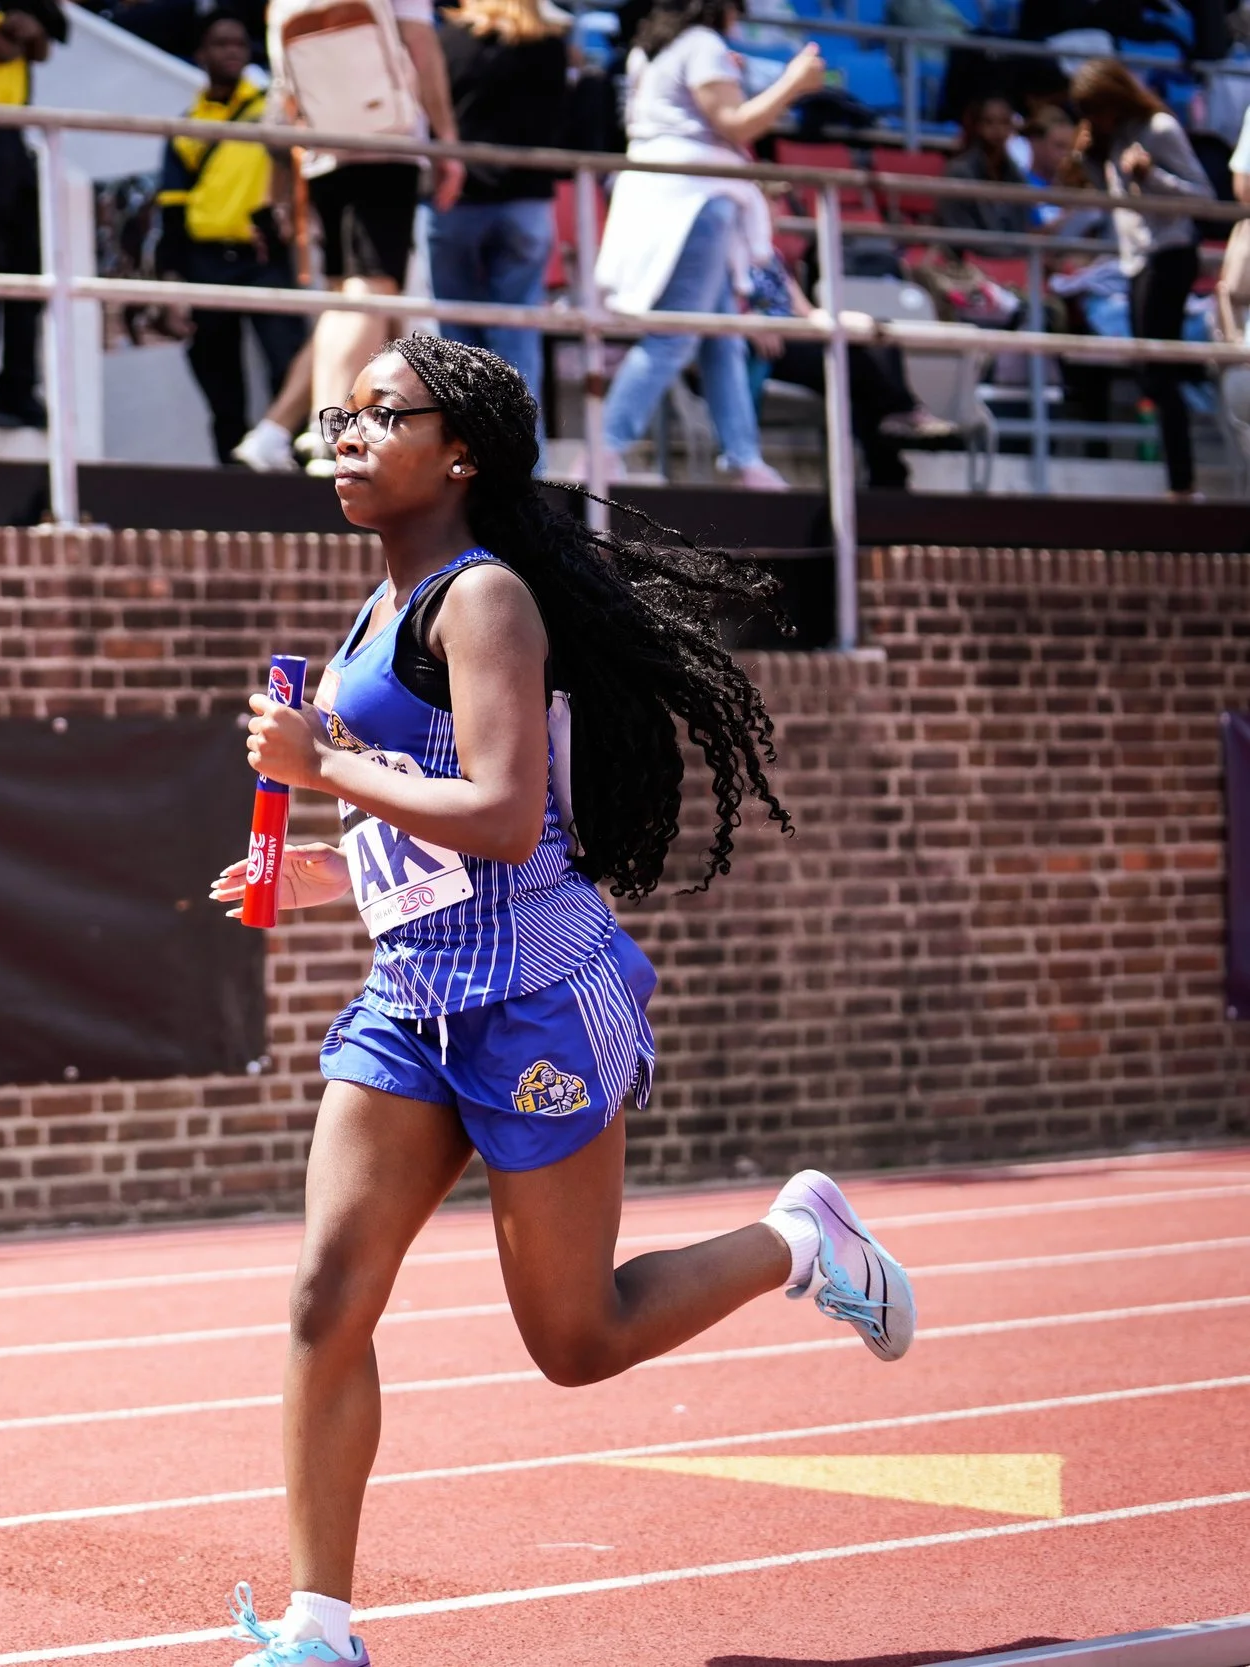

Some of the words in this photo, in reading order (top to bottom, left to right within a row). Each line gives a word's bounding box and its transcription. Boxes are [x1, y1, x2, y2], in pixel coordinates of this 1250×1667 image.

[246, 831, 266, 885] 250
[263, 834, 277, 885] AMERICA
[356, 821, 446, 903] AK
[397, 886, 435, 916] 250
